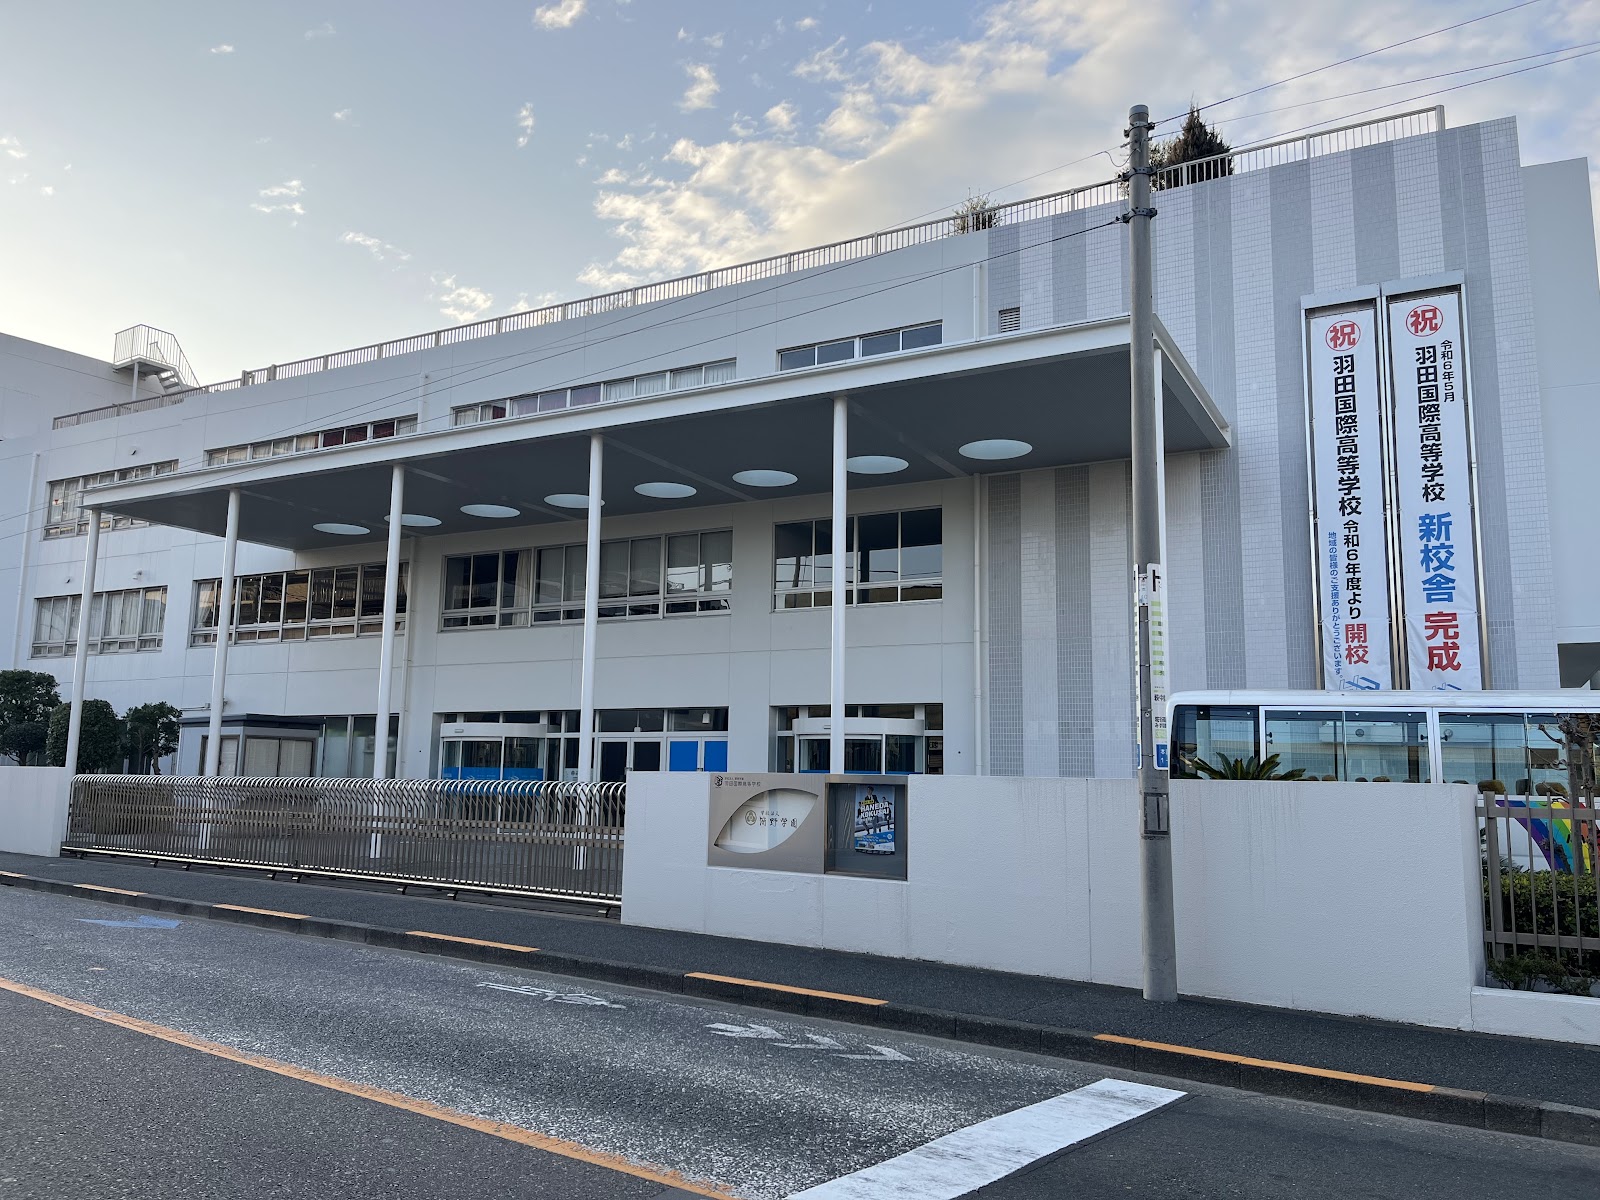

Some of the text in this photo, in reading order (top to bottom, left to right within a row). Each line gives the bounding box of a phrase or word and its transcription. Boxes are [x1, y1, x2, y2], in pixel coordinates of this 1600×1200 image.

[1329, 323, 1357, 349] 祝
[1409, 306, 1439, 334] 祝
[1440, 339, 1455, 403] 令和6年5月
[1332, 353, 1363, 517] 羽田国際高等学校
[1414, 345, 1462, 672] 羽田国際高等学校 新校舎 完成
[1344, 623, 1369, 665] 開校
[860, 802, 889, 813] HANEDA
[860, 808, 890, 818] KOKUSAI
